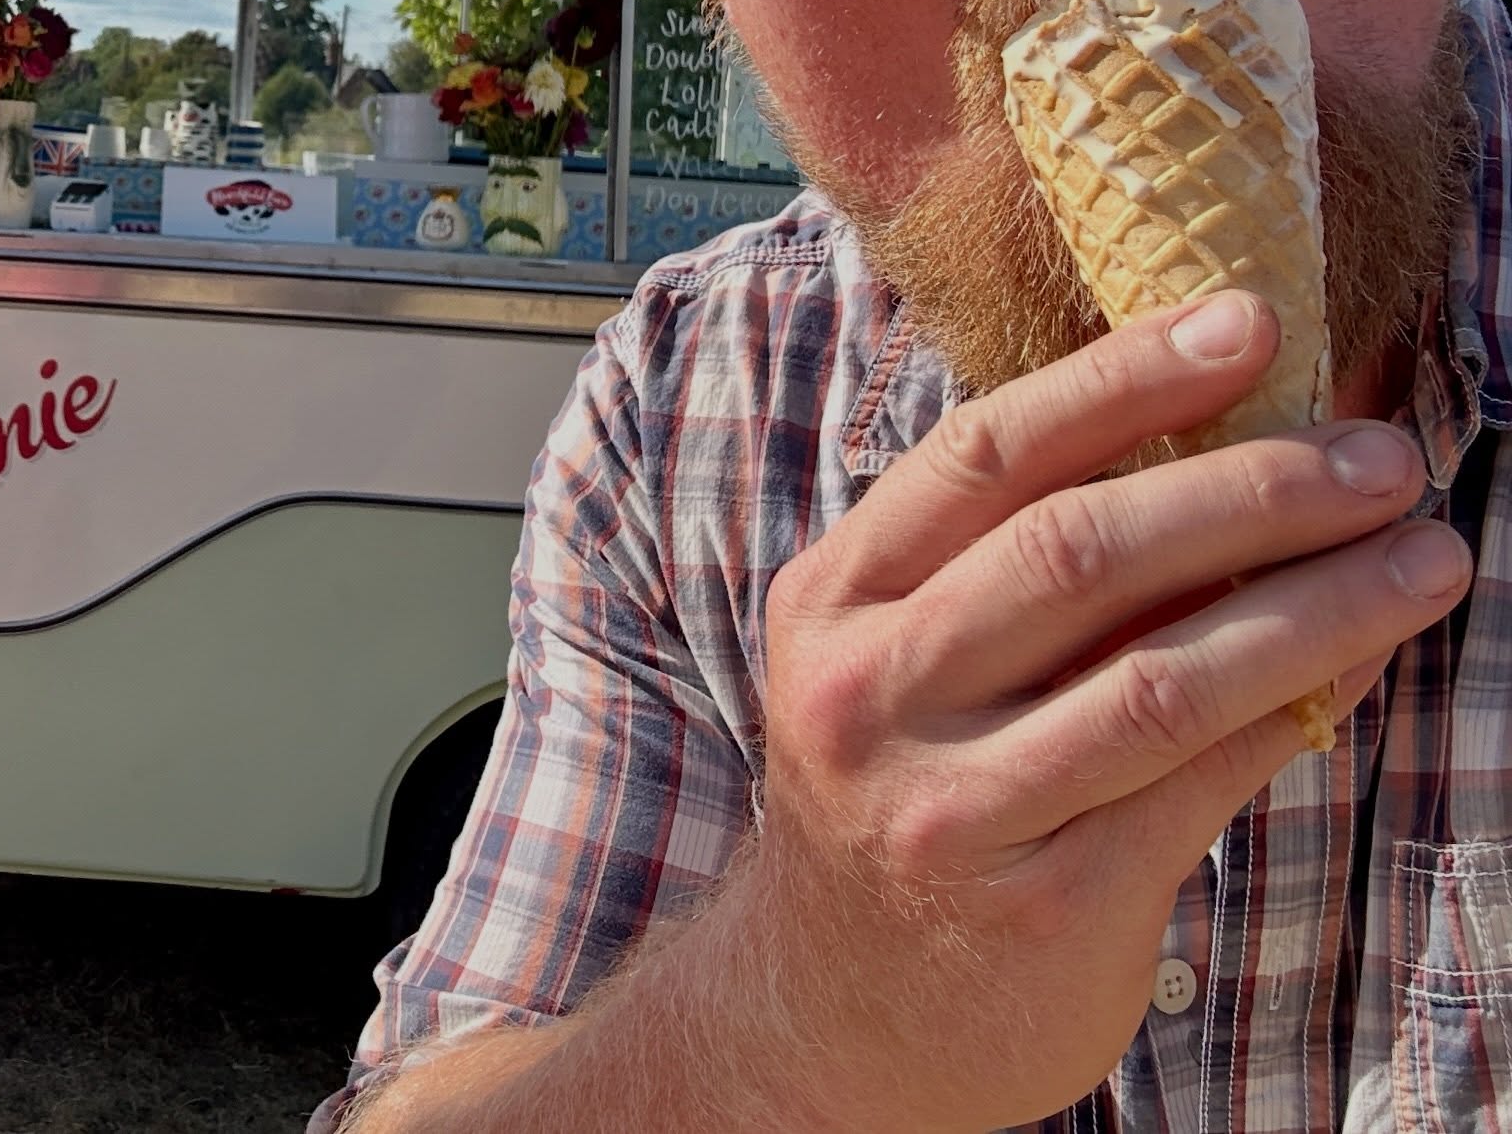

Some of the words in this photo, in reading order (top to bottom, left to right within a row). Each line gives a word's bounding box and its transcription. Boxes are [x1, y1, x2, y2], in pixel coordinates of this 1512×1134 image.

[645, 38, 724, 73] Doubl
[661, 75, 721, 112] Loll
[645, 184, 699, 222] Dog
